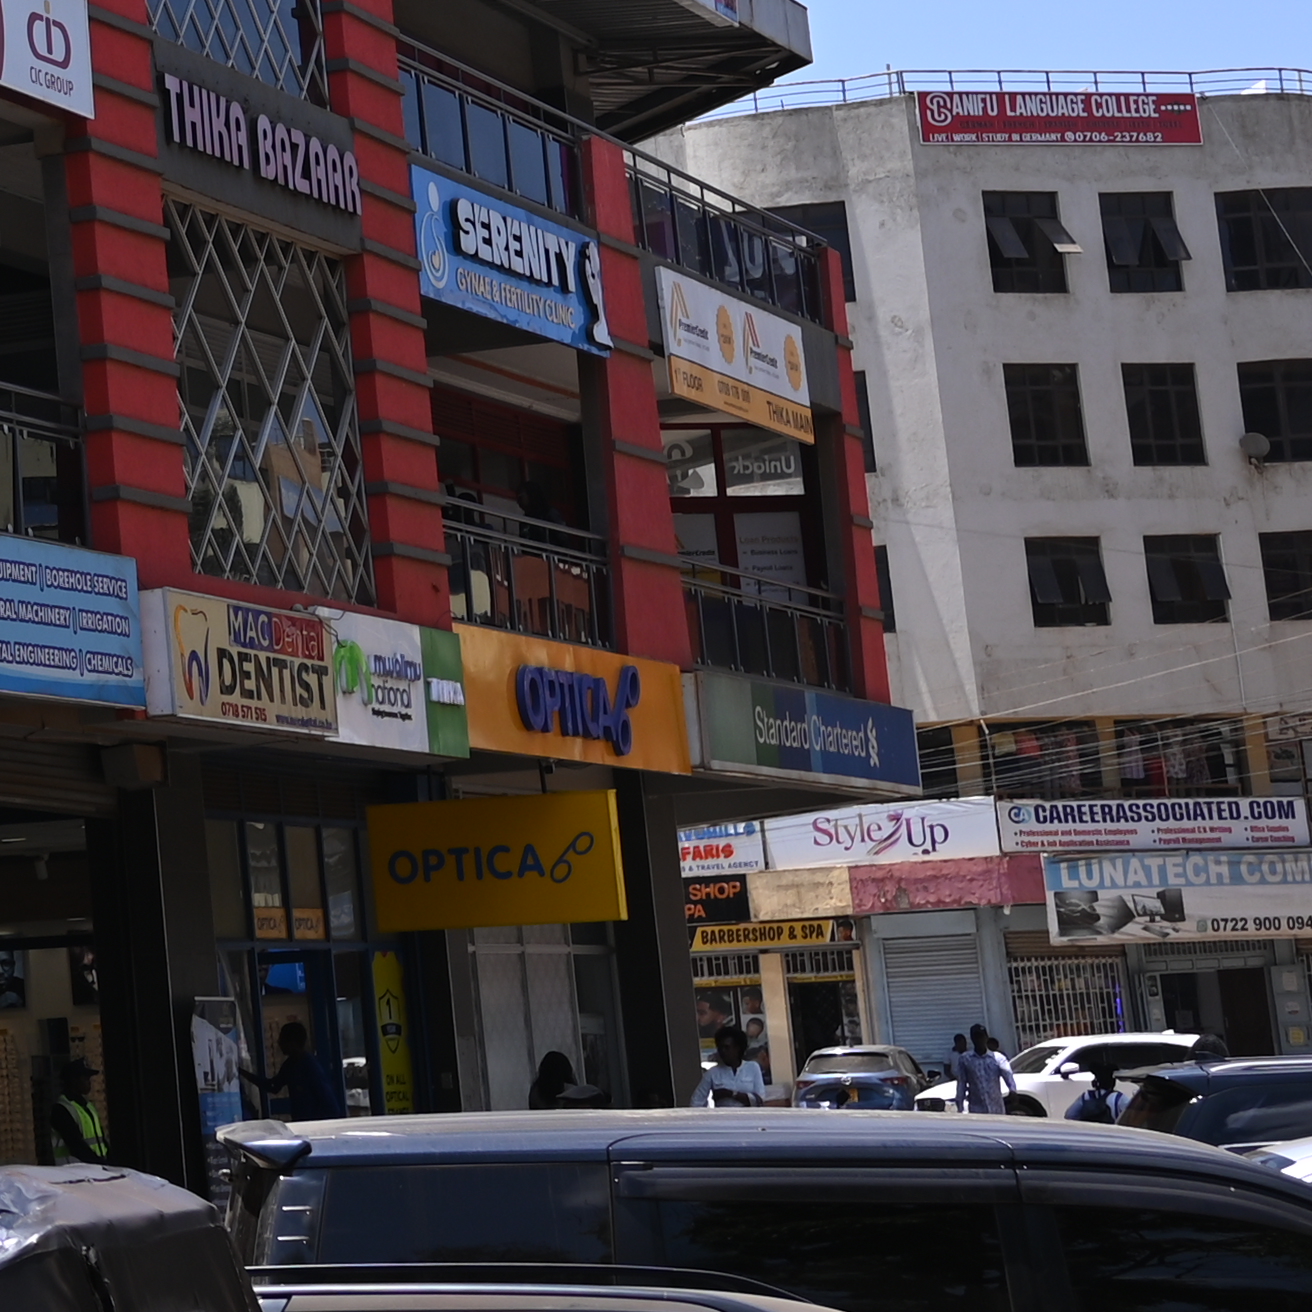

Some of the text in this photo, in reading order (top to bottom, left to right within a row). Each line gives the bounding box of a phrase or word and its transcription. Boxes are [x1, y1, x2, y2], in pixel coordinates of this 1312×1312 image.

[29, 65, 75, 98] CIC GROUP
[1004, 94, 1160, 118] LANGUAGE COLLEGE
[164, 72, 363, 216] THIKA BAZAAR
[929, 133, 948, 142] LIVE
[952, 133, 977, 141] WORK
[982, 133, 1010, 141] STUDY
[1022, 133, 1061, 141] GERMANY
[457, 199, 576, 293] SERENITY
[456, 267, 576, 330] GYNAE & FERTILITY CLINIC
[682, 371, 703, 392] FLOOR
[766, 401, 792, 426] THIKA
[792, 411, 813, 436] MAIN
[44, 566, 92, 595] BOREHOLE
[93, 572, 128, 600] SERVICE
[18, 601, 71, 628] MACHINERY
[78, 608, 131, 638] IRRIGATION
[229, 610, 324, 659] MAC Dental
[14, 642, 77, 670] ENGINEERING
[84, 650, 134, 678] CHEMICALS
[217, 647, 328, 711] DENTIST
[517, 664, 616, 743] OPTICA
[754, 705, 866, 758] Standard Chartered
[1032, 800, 1297, 825] CAREERASSOCIATED.COM
[811, 813, 950, 854] Style Up
[388, 843, 546, 885] OPTICA
[696, 859, 760, 872] TRAVEL AGENCY
[1060, 854, 1230, 888] LUNATECH
[689, 881, 742, 901] SHOP
[700, 923, 825, 945] BARBERSHOP & SPA
[1211, 918, 1249, 932] 0722
[1253, 917, 1282, 931] 900
[385, 1073, 407, 1086] ON ALL
[385, 1089, 411, 1102] OPTICAL
